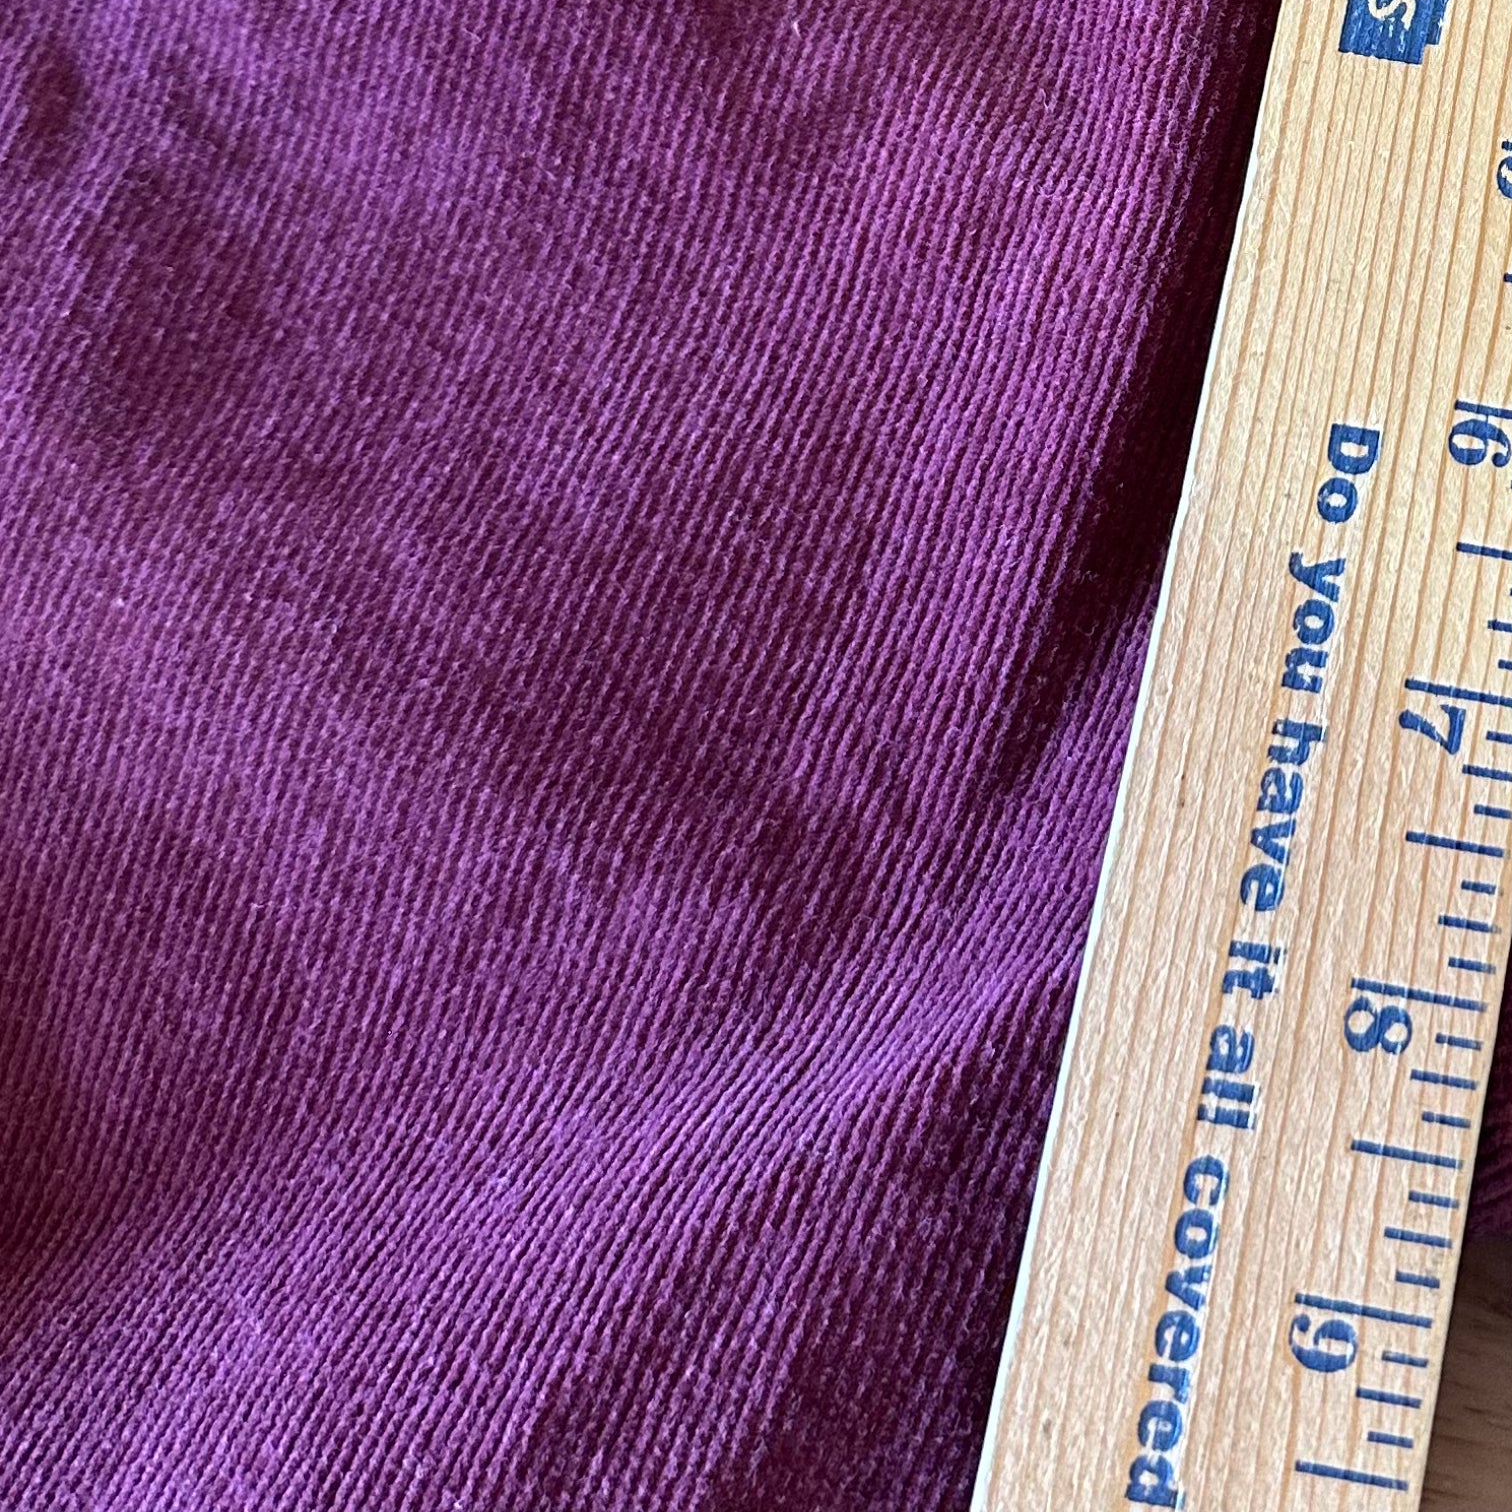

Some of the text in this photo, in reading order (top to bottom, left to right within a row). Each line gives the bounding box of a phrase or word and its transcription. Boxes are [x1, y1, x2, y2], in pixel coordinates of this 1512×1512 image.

[1447, 415, 1512, 469] 6
[1398, 702, 1467, 756] 7
[1125, 422, 1381, 1510] Do you have it all covered
[1343, 996, 1413, 1056] 8
[1290, 1314, 1358, 1373] 9
